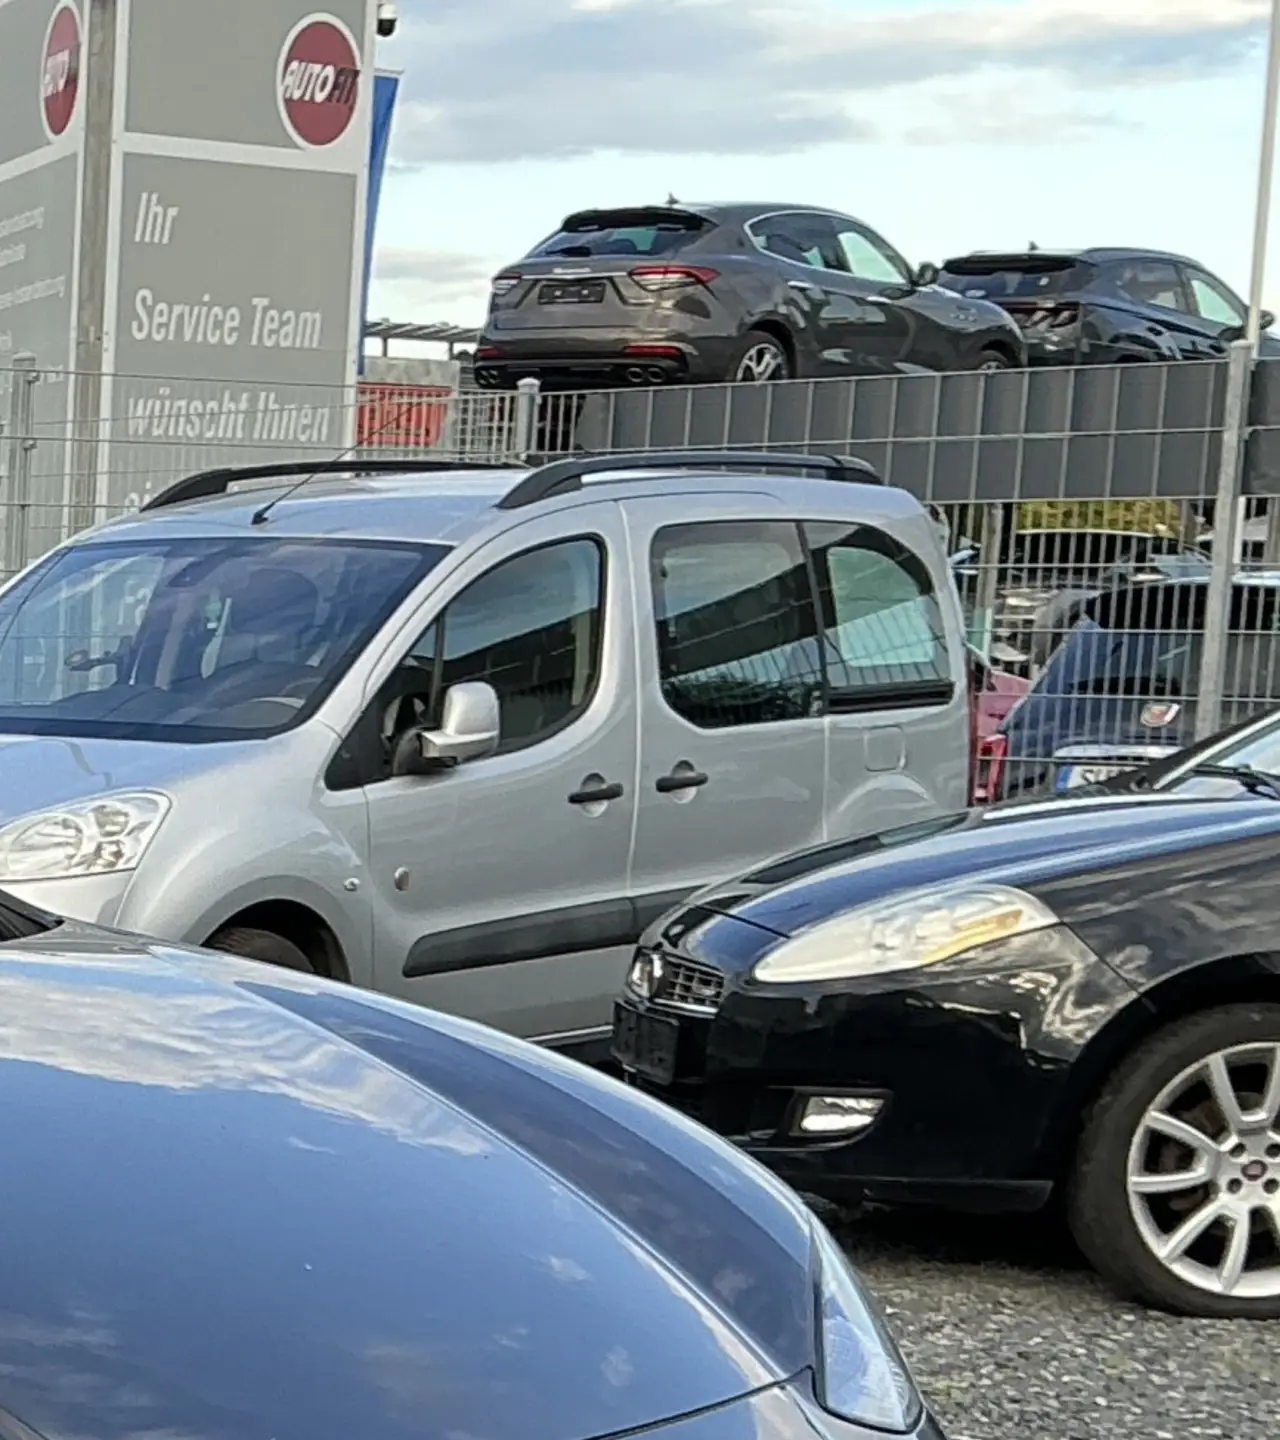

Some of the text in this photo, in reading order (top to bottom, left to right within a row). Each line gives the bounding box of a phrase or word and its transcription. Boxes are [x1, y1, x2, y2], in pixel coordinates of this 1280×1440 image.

[134, 191, 180, 245] Ihr
[131, 287, 241, 346] Service
[249, 297, 324, 350] Team
[127, 386, 331, 443] wünscht Ihnen
